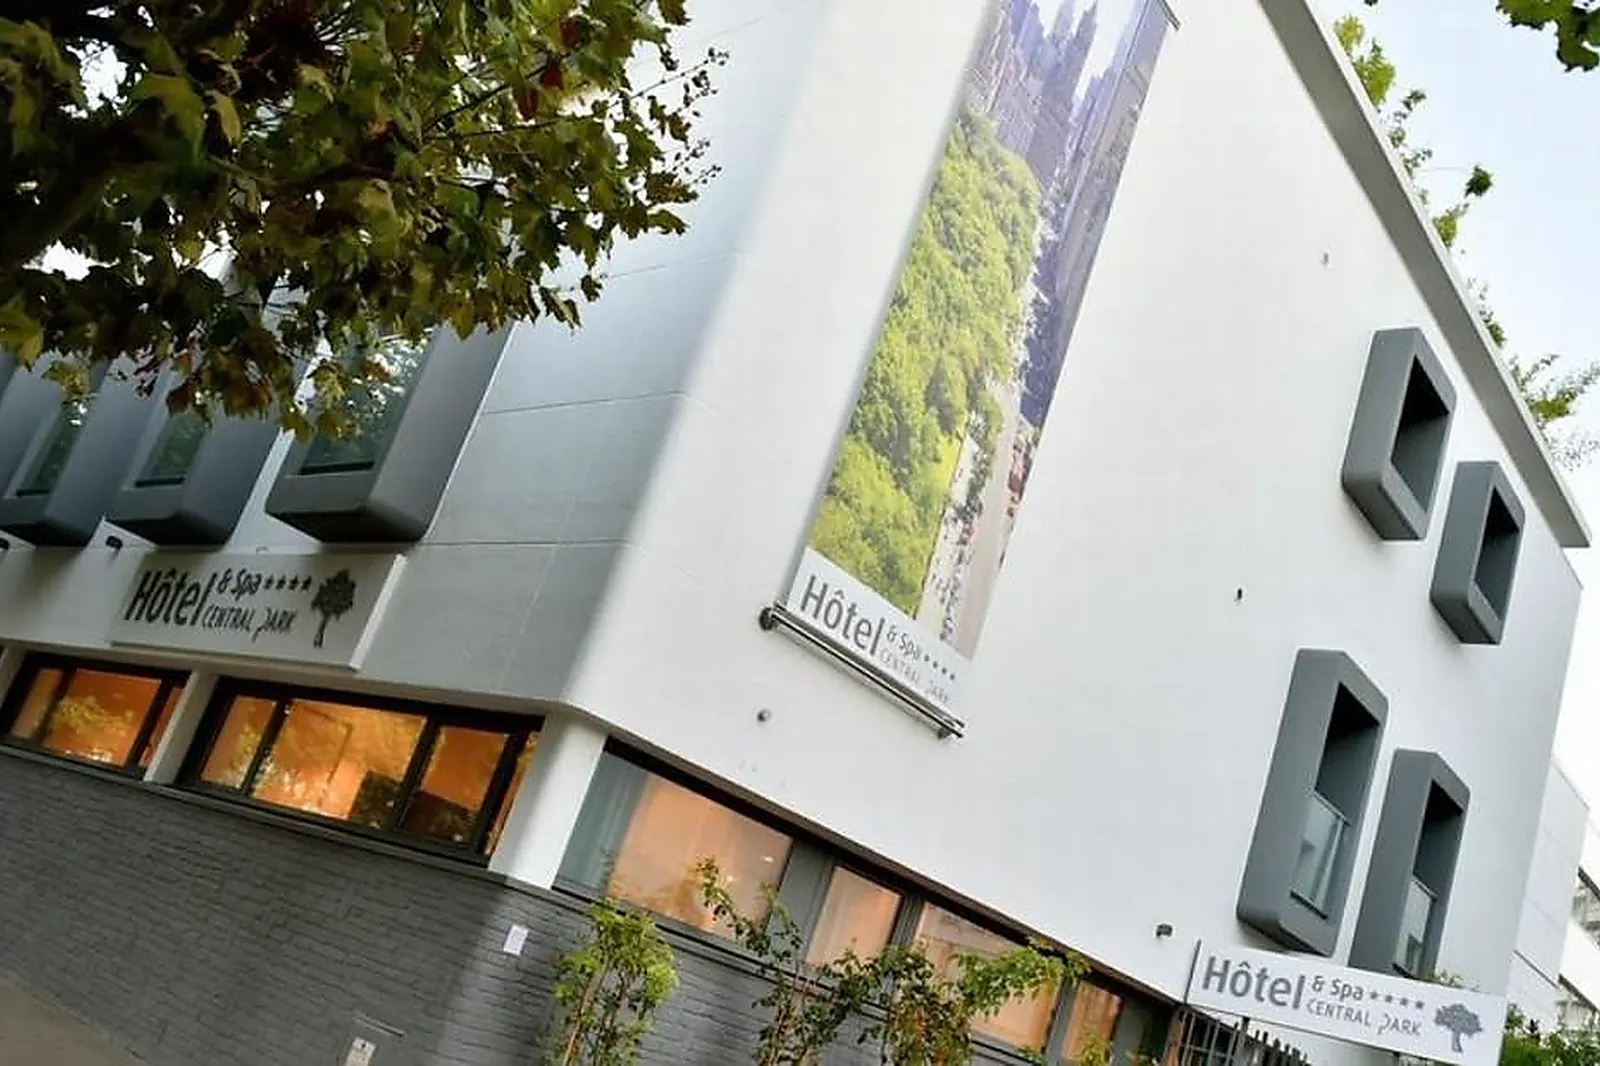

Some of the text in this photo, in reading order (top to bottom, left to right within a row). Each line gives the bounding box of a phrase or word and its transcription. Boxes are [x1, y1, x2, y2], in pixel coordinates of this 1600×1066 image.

[124, 568, 262, 627] Hôtel & Spa
[201, 604, 255, 633] CENTRAL
[800, 574, 921, 661] Hôtel & Spa
[1201, 956, 1365, 1010] Hôtel & Spa
[1306, 999, 1422, 1037] CENTRAL PARK
